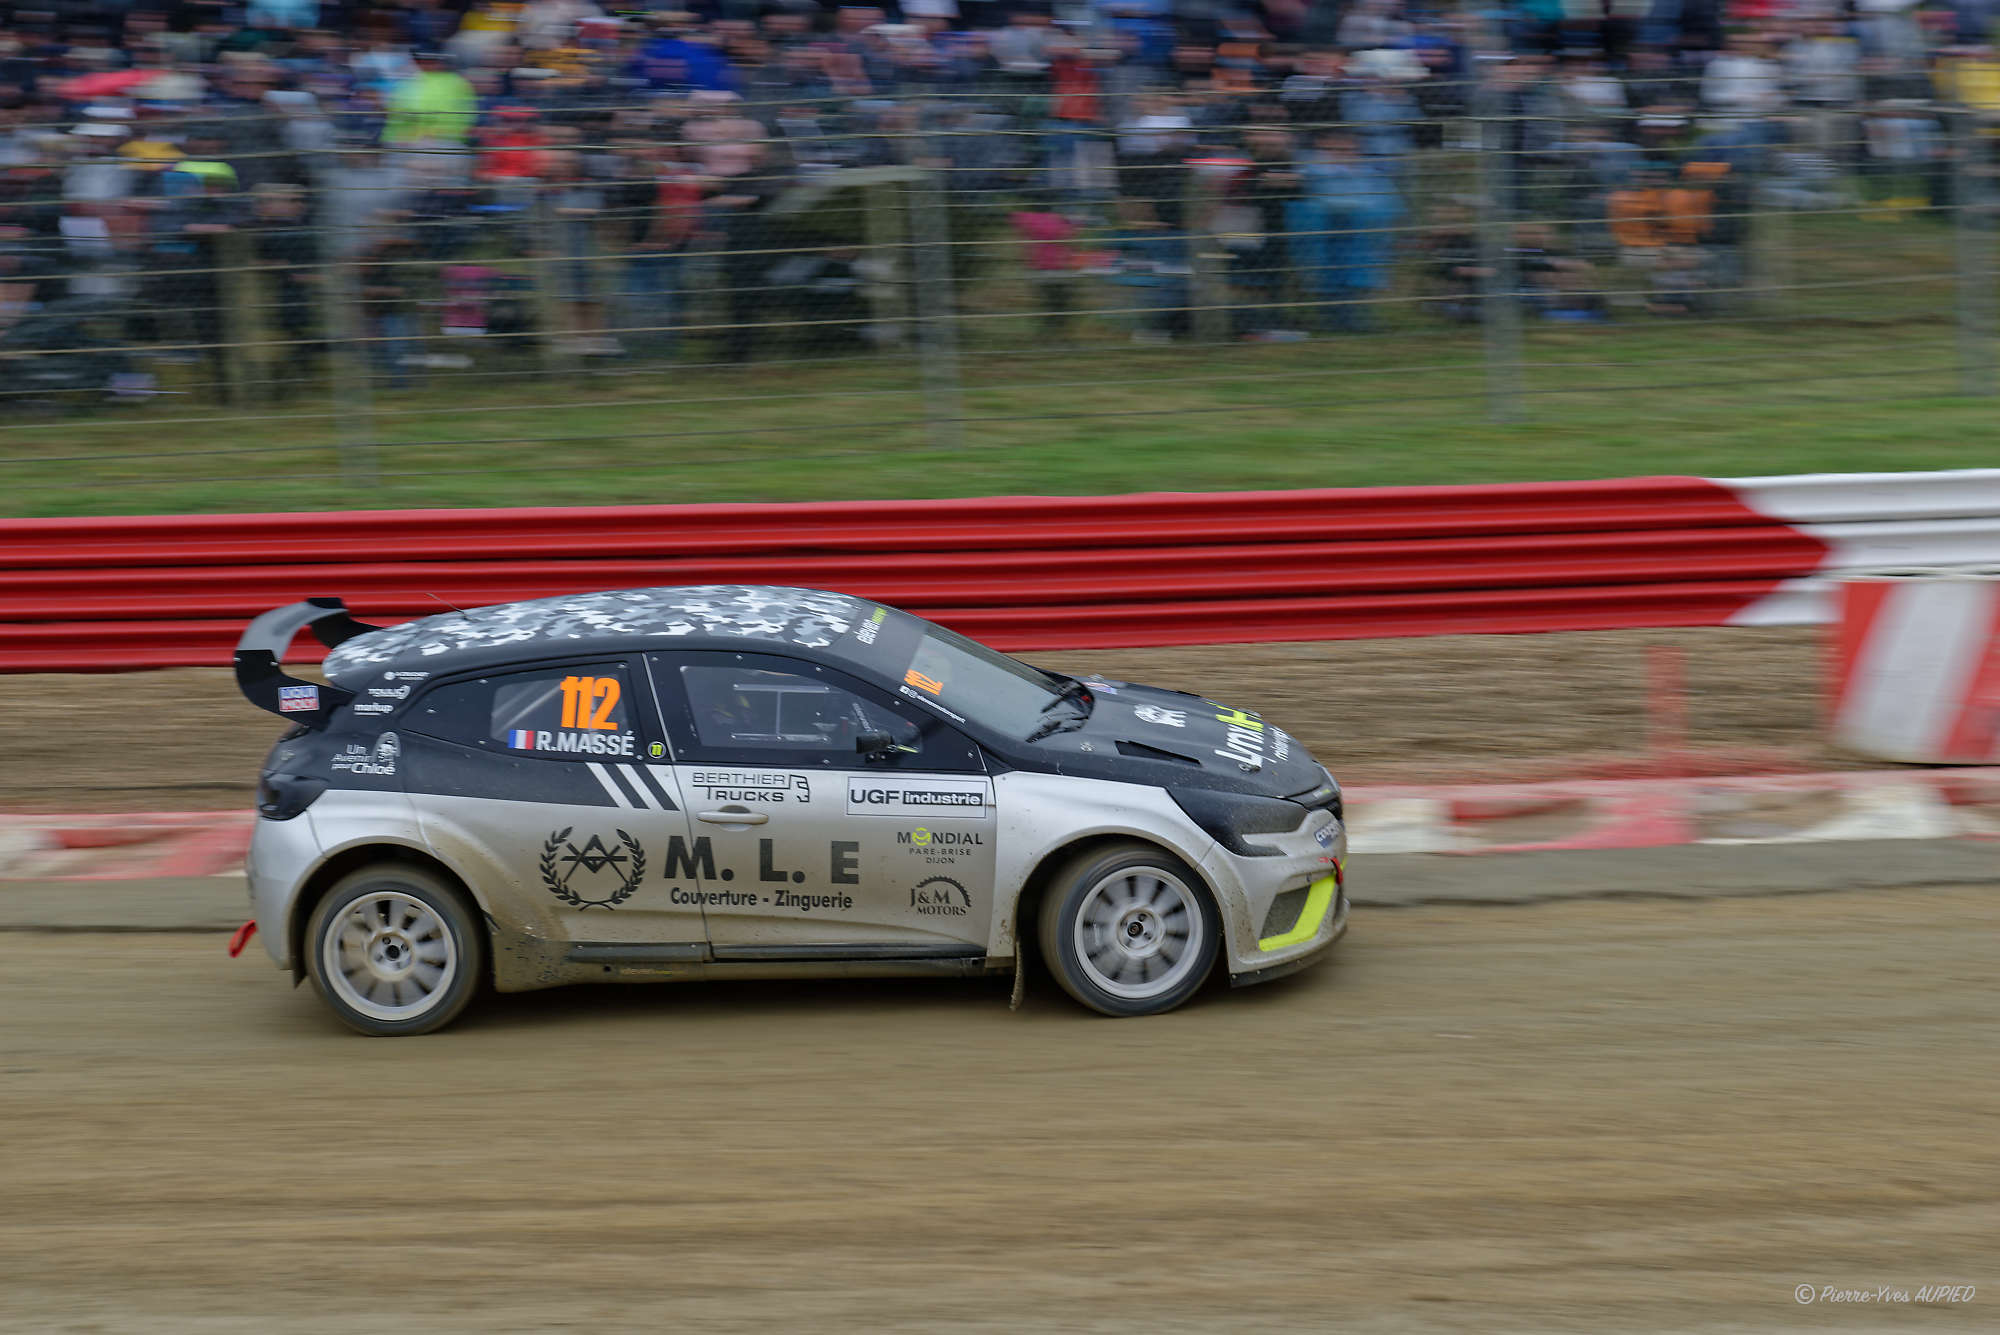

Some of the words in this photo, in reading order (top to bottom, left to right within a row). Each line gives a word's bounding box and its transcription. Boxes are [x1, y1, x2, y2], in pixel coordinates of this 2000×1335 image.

[560, 676, 621, 731] 112
[535, 730, 634, 756] R.MASSÉ
[693, 772, 785, 785] BERTHIER
[706, 786, 784, 802] TRUCKS
[850, 789, 901, 804] UGF
[904, 791, 983, 806] industrie
[909, 847, 972, 857] PARE-BRISE
[831, 840, 860, 884] E
[670, 886, 757, 907] Couverture
[774, 889, 853, 912] Zinguerie
[916, 905, 967, 916] MOTORS
